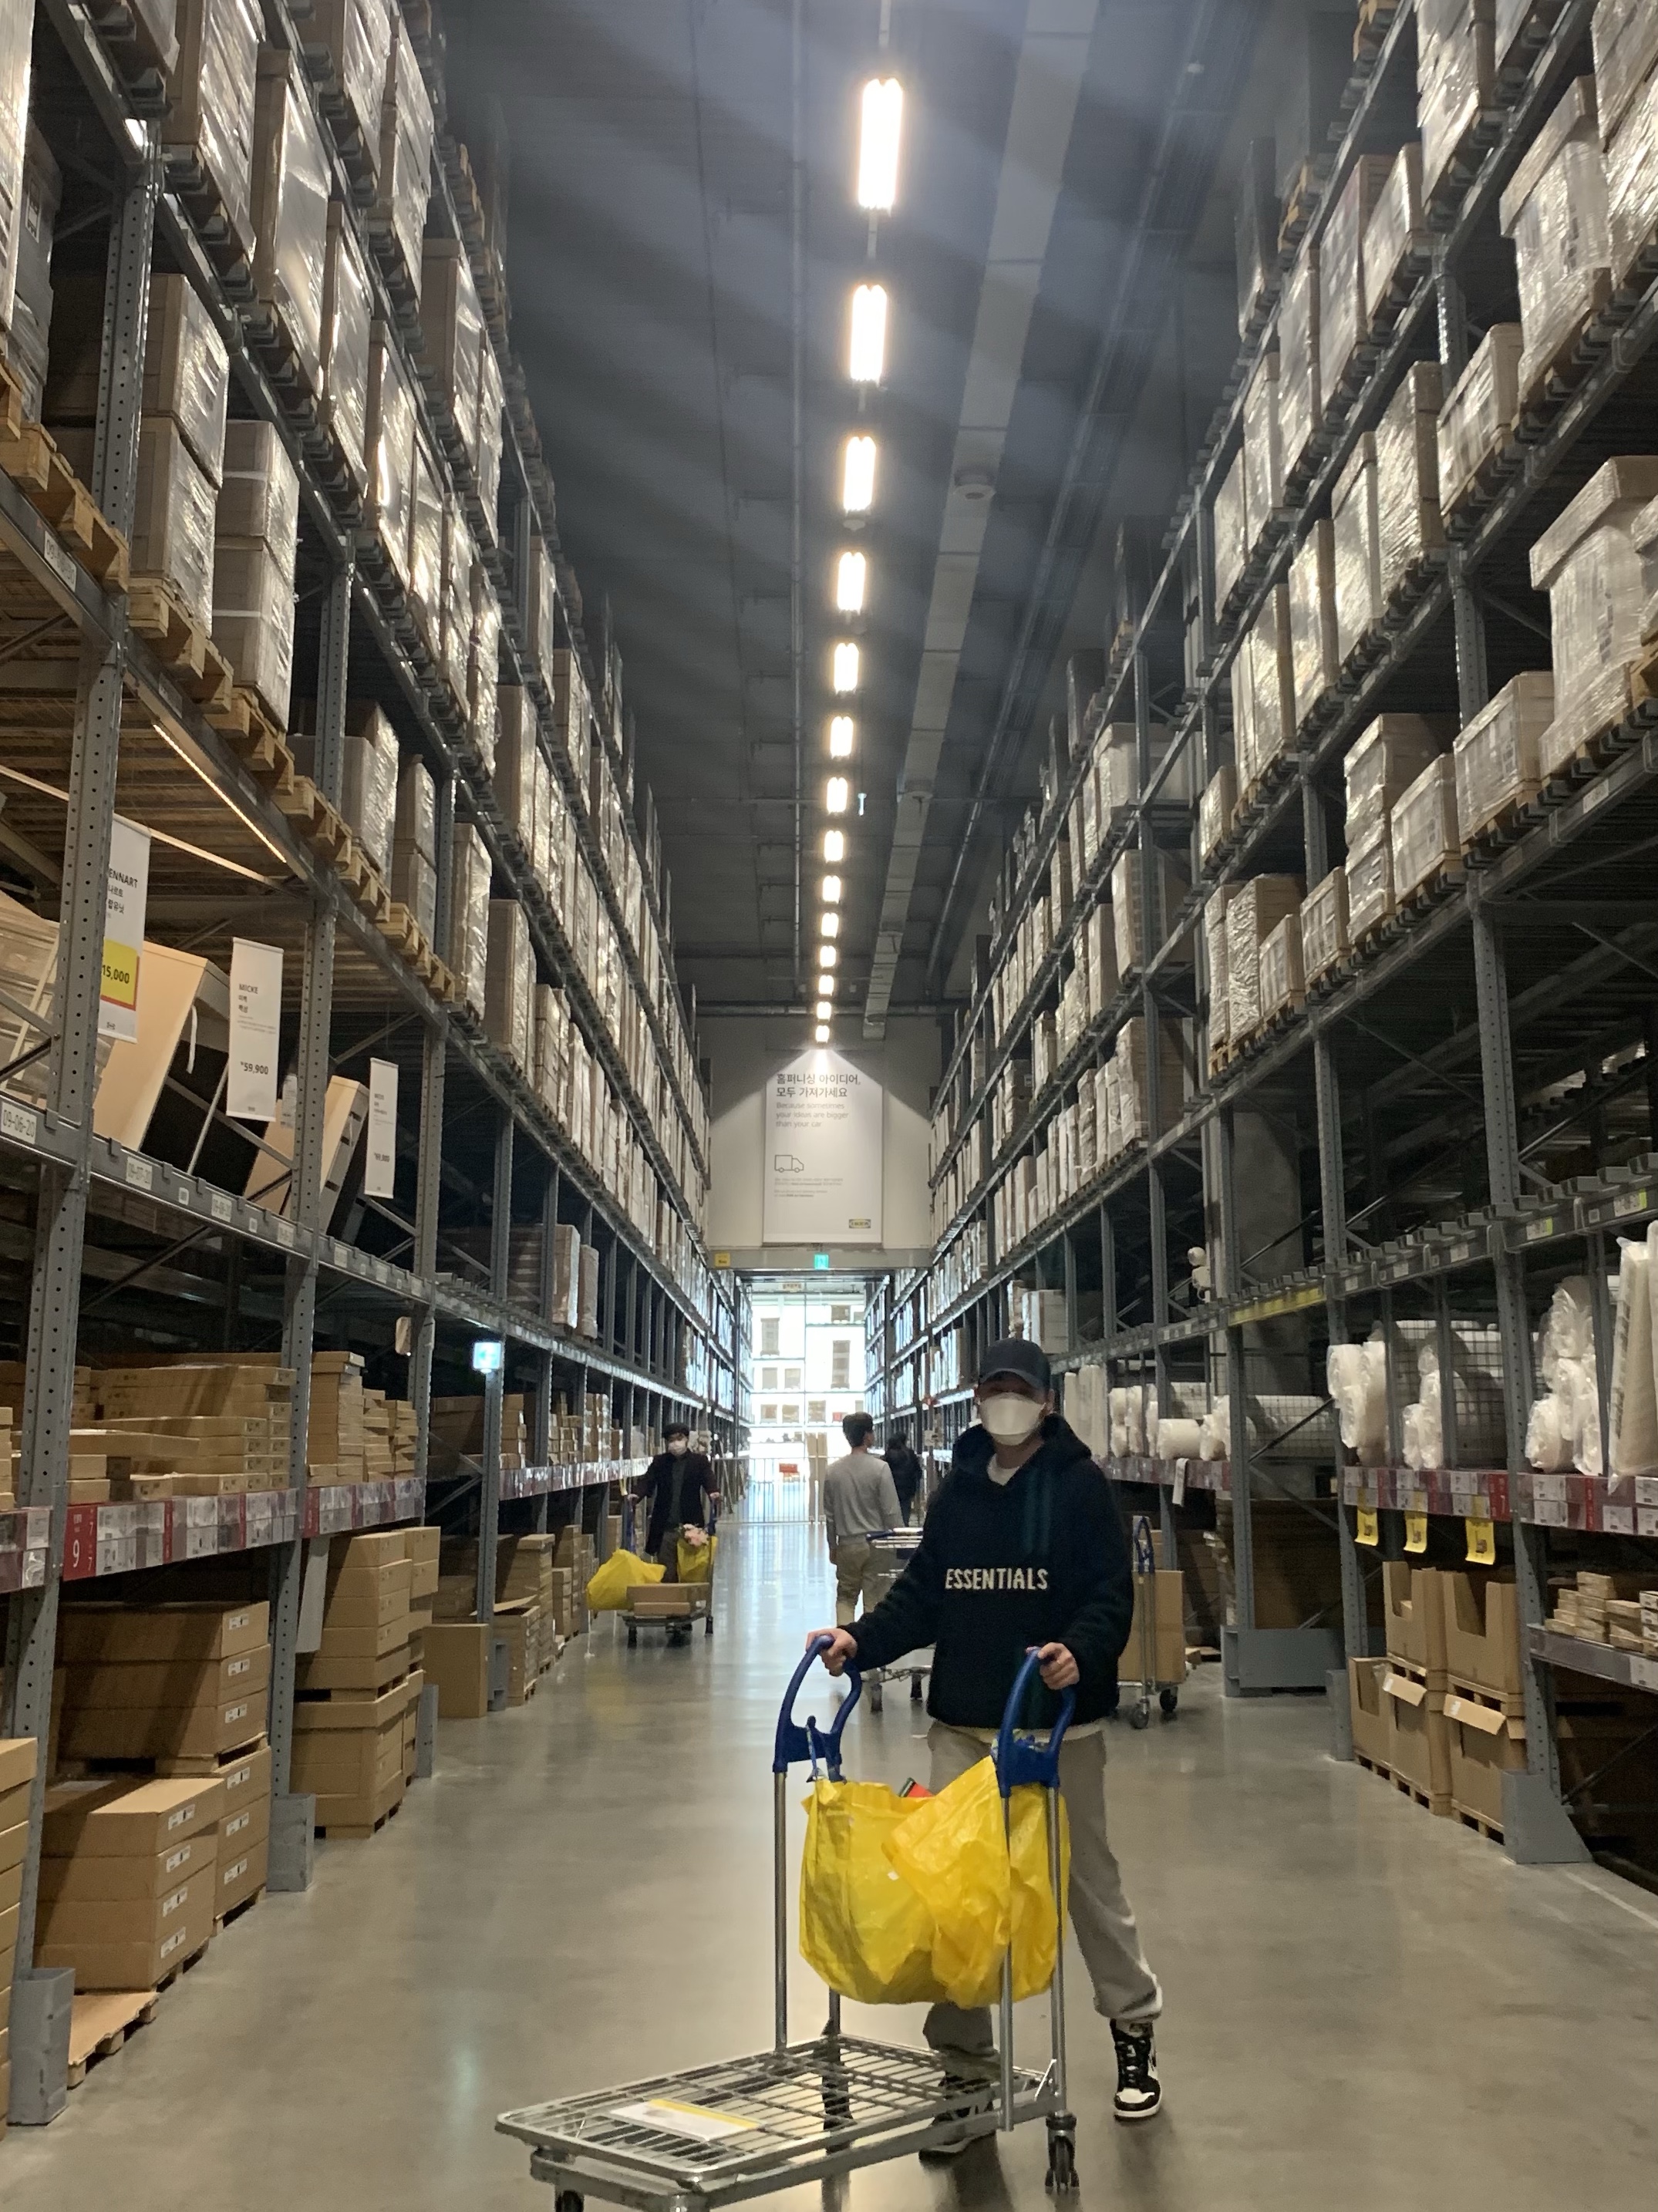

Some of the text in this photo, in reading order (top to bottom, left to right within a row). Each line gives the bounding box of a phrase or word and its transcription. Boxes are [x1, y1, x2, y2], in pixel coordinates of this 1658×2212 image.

[109, 868, 138, 888] ENNART
[107, 884, 123, 897] 나르트
[108, 899, 124, 914] 랍유닛
[102, 965, 130, 985] 15,000
[777, 1073, 815, 1085] 홈퍼니싱
[777, 1087, 848, 1098] 모두 가져가세요
[826, 1111, 849, 1120] bigger
[89, 1522, 94, 1535] 7
[72, 1539, 80, 1568] 9
[945, 1567, 1049, 1591] ESSENTIALS
